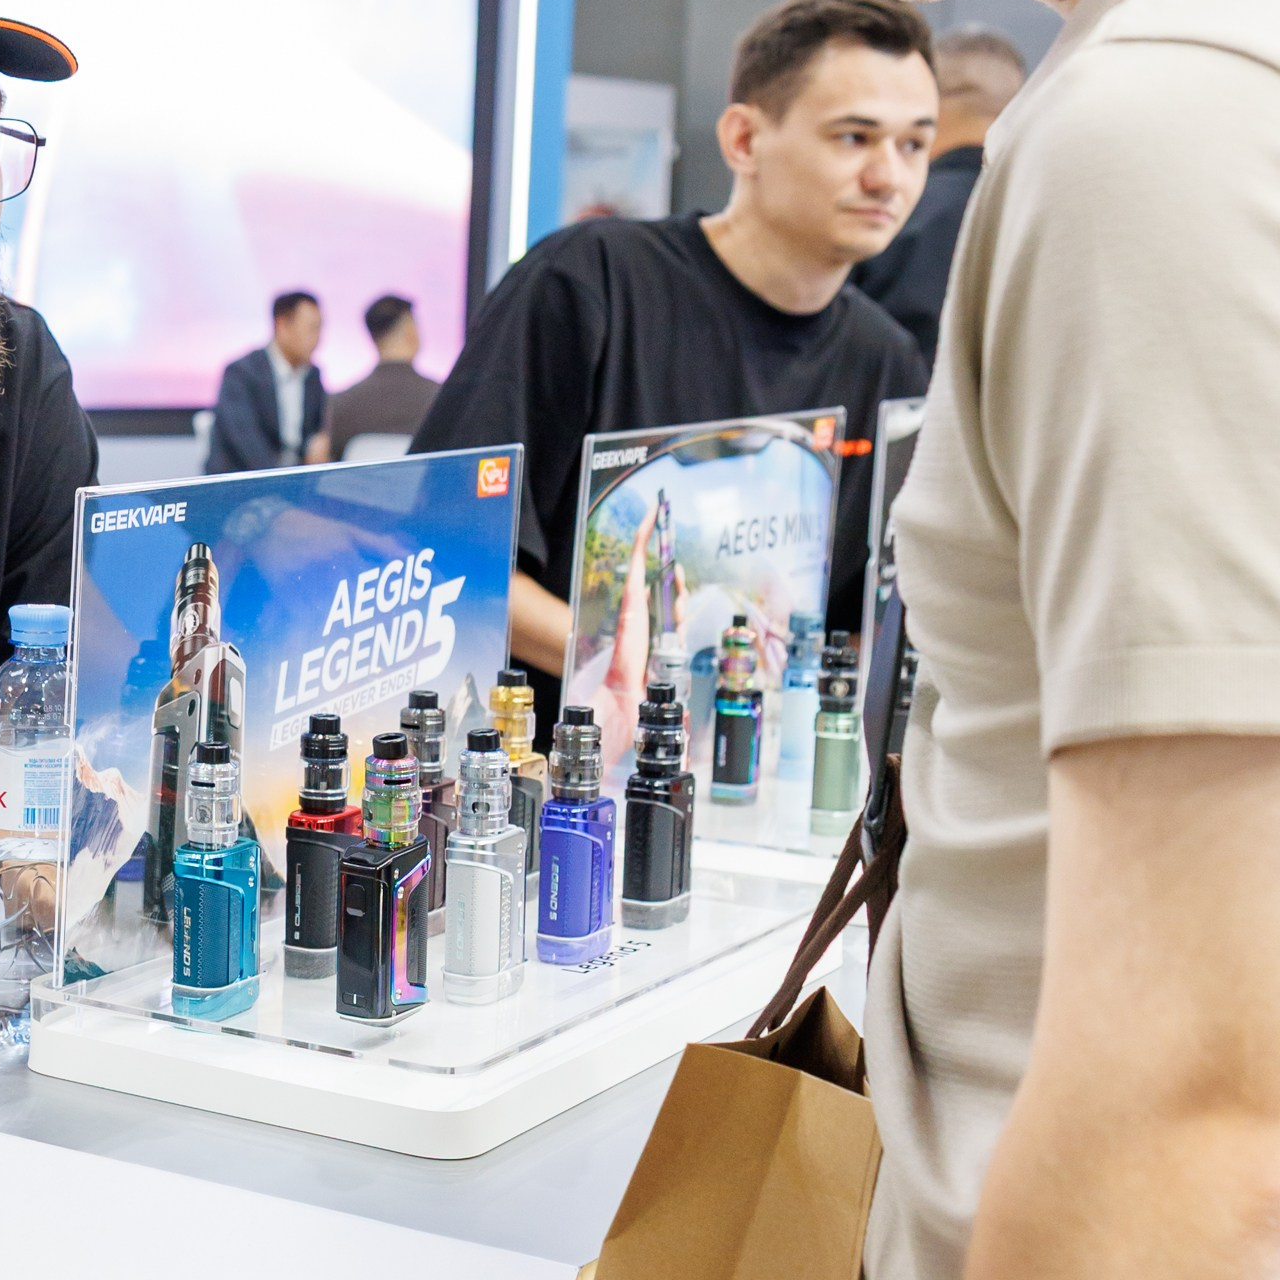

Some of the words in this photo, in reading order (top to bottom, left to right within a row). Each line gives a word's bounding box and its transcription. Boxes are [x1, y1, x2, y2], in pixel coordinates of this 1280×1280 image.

[592, 446, 649, 470] GEEKVAPE
[90, 502, 188, 534] GEEKVAPE
[716, 515, 778, 561] AEGIS
[322, 547, 436, 637] AEGIS
[274, 608, 424, 715] LEGEND
[416, 575, 467, 687] 5
[379, 669, 414, 698] ENDS
[550, 855, 560, 912] LEGEND
[561, 945, 641, 975] Legend
